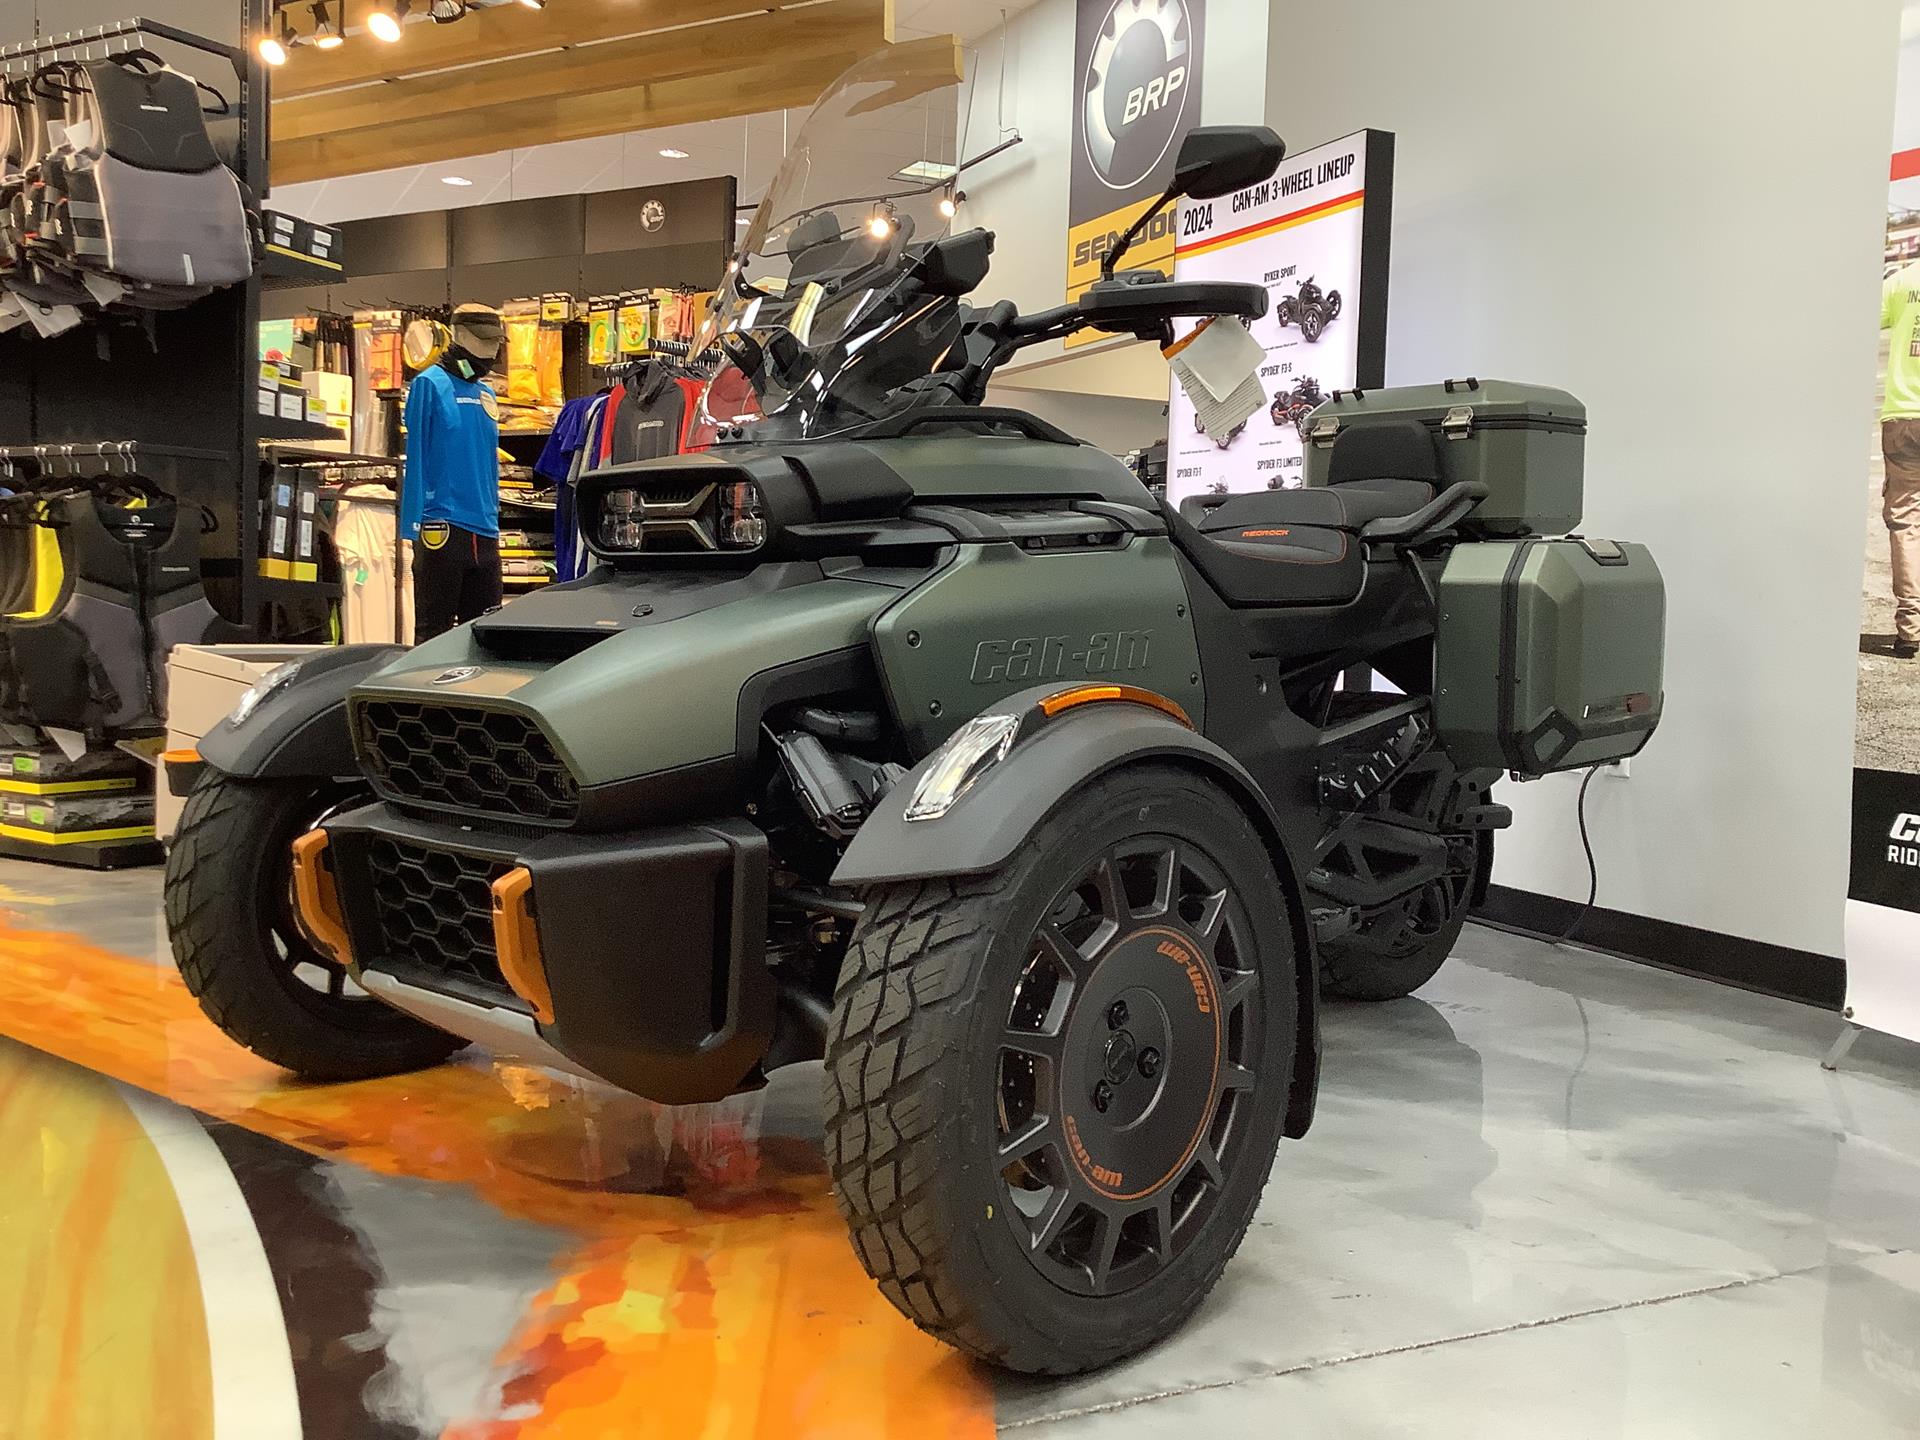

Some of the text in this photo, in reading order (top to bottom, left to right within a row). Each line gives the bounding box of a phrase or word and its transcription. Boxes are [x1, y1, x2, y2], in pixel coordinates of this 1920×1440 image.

[1122, 66, 1185, 126] BRP
[1184, 153, 1355, 235] 2024 CAN-AM 3-WHEEL LINEUP
[1264, 265, 1297, 283] RYKER SPORT
[1261, 364, 1280, 378] SPYDER
[1177, 468, 1193, 479] SPYDER
[1257, 456, 1303, 471] SPYDER F3 LIMITED
[970, 629, 1154, 685] can-am
[1157, 940, 1211, 1013] can-am
[1066, 1115, 1123, 1187] can-am
